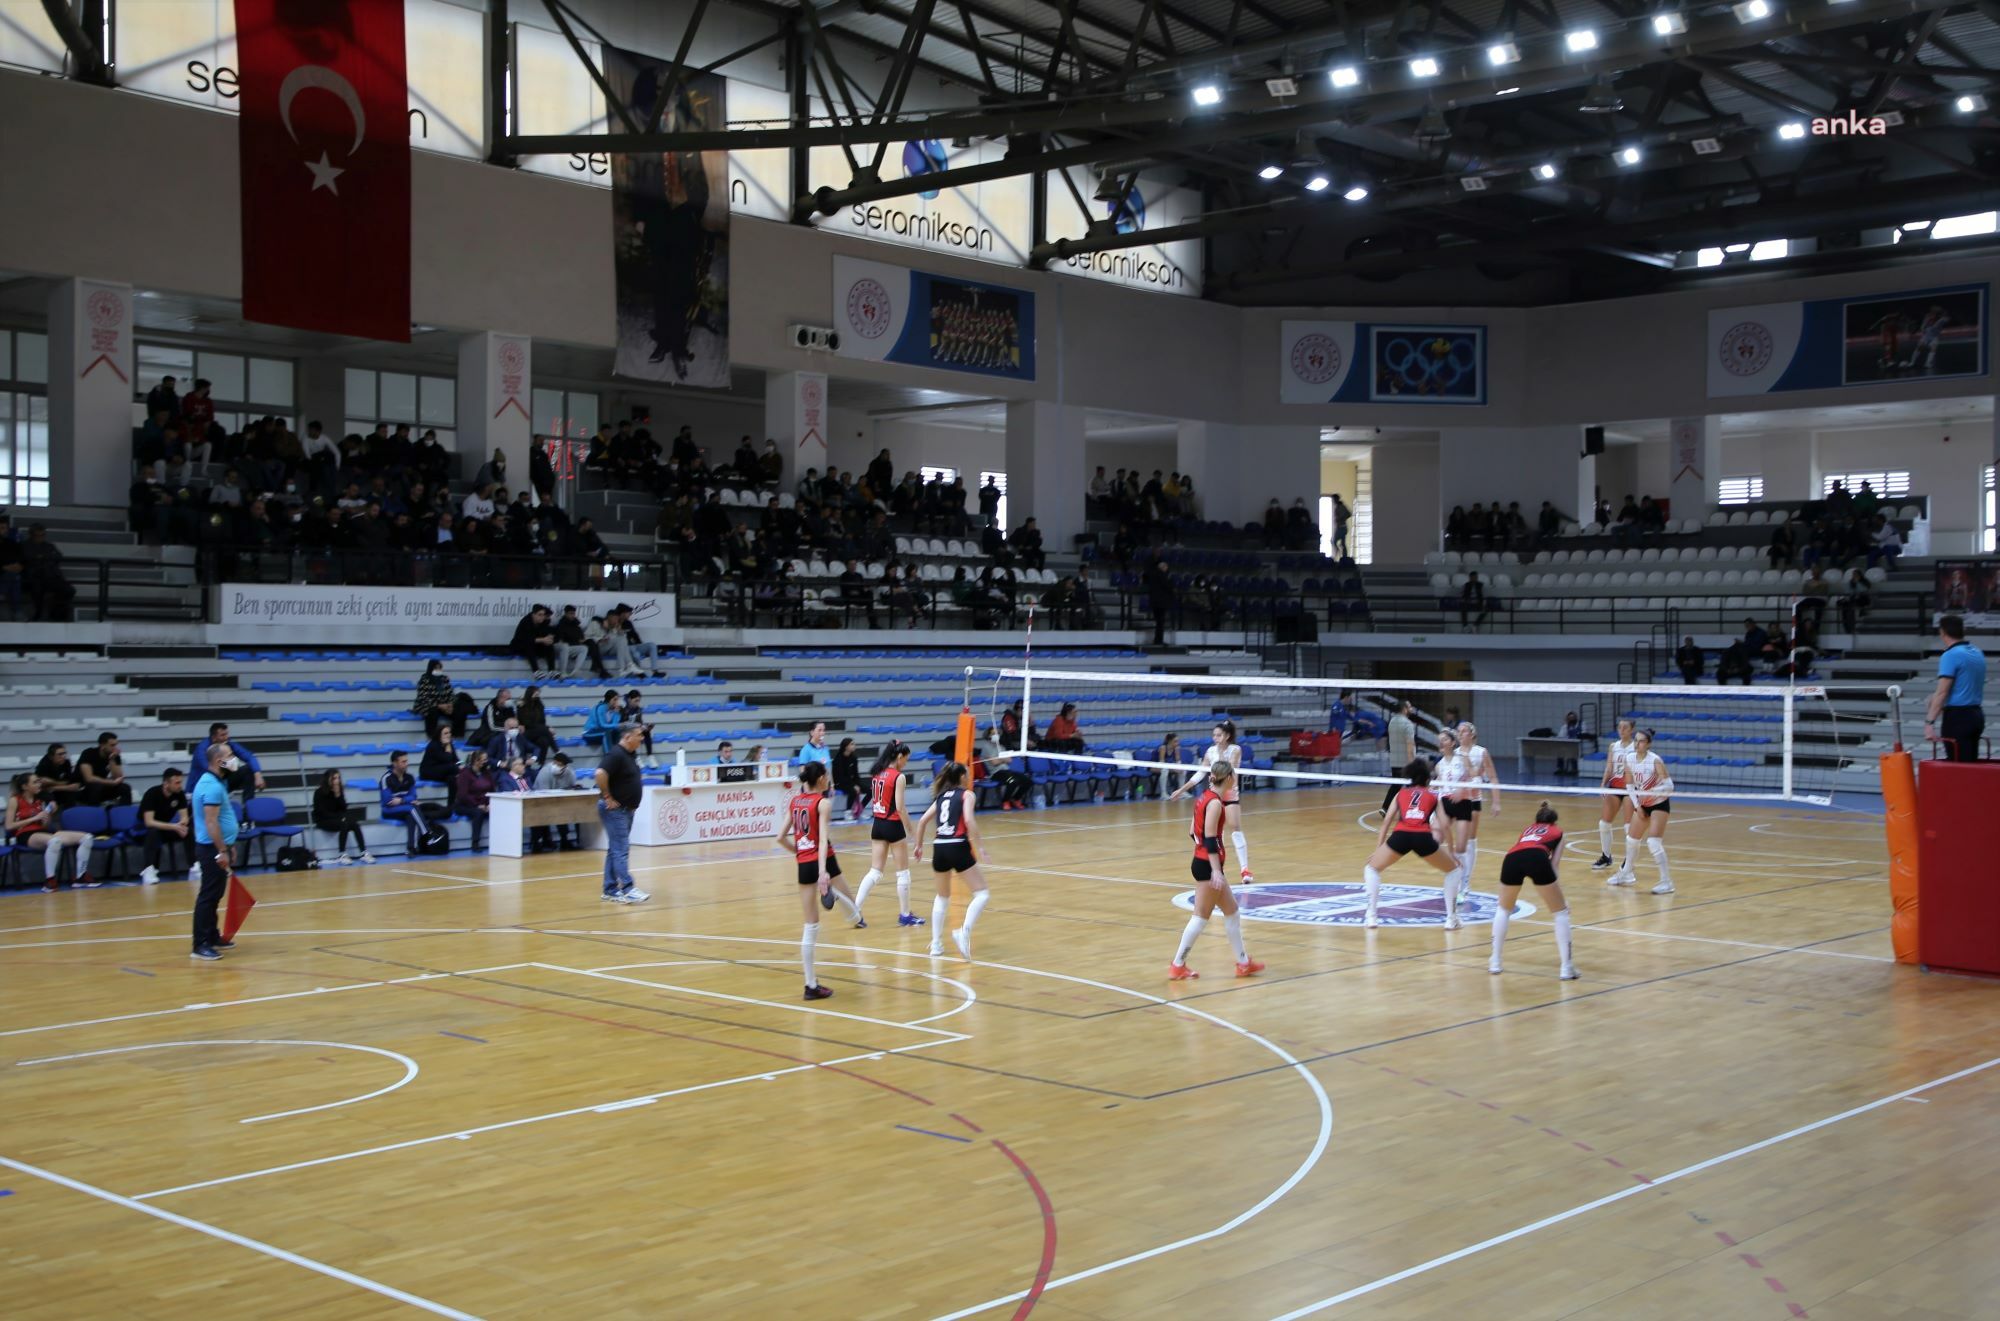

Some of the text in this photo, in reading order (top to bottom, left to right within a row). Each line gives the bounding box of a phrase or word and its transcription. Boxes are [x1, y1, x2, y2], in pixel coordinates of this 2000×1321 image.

[851, 203, 994, 252] seramiksan
[233, 592, 259, 615] Ben
[263, 601, 333, 621] sporcunun
[336, 594, 363, 616] zeki
[436, 597, 490, 617] zamanda
[717, 791, 755, 804] MANİSA
[695, 804, 776, 824] GENÇLİK VE SPOR
[793, 807, 810, 836] 10
[939, 799, 951, 823] 8
[710, 820, 772, 837] MÜDÜRLÜĞÜ
